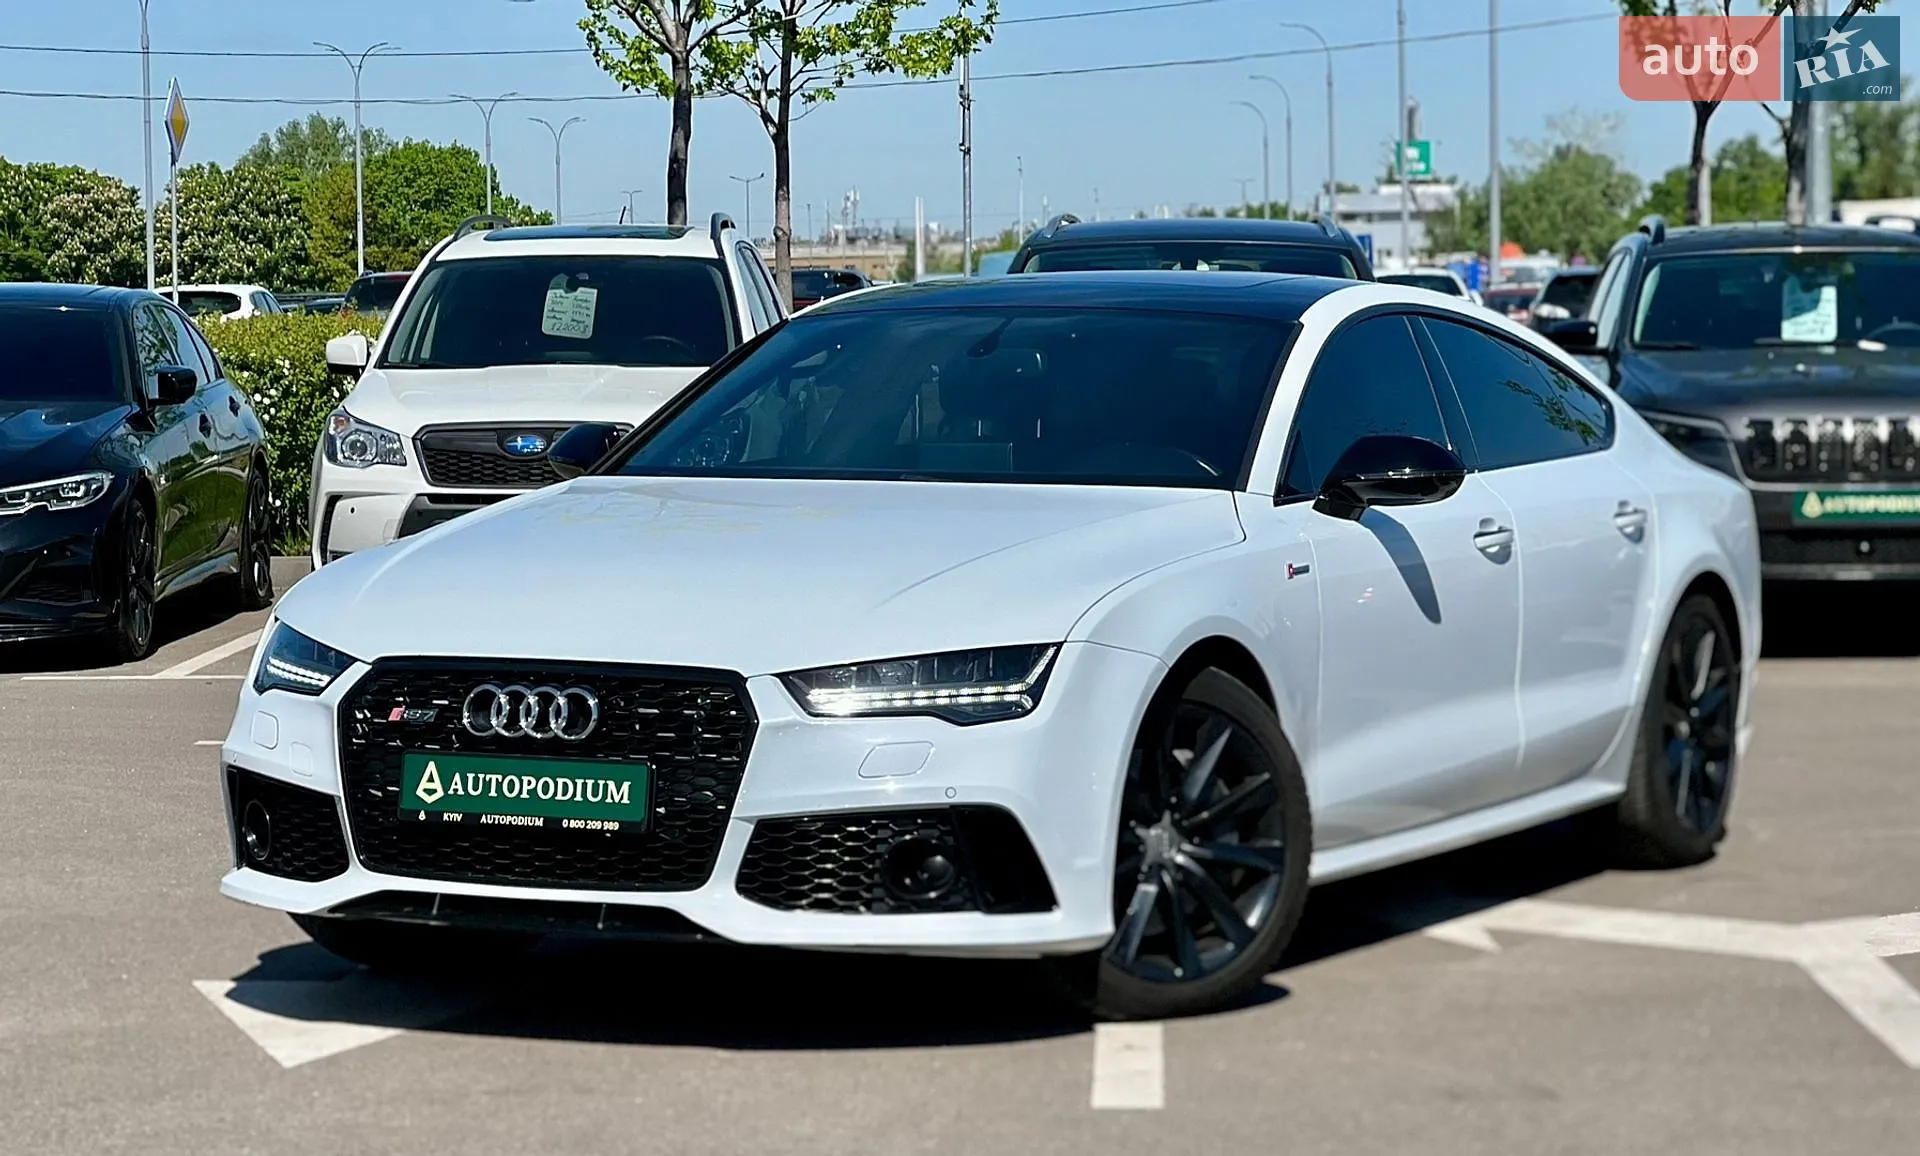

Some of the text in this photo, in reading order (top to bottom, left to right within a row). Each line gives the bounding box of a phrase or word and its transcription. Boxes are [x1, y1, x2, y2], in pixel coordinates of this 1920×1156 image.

[447, 772, 632, 804] AUTOPODIUM
[443, 812, 619, 831] KYIV AUTOPODIUM 0 800 209 989
